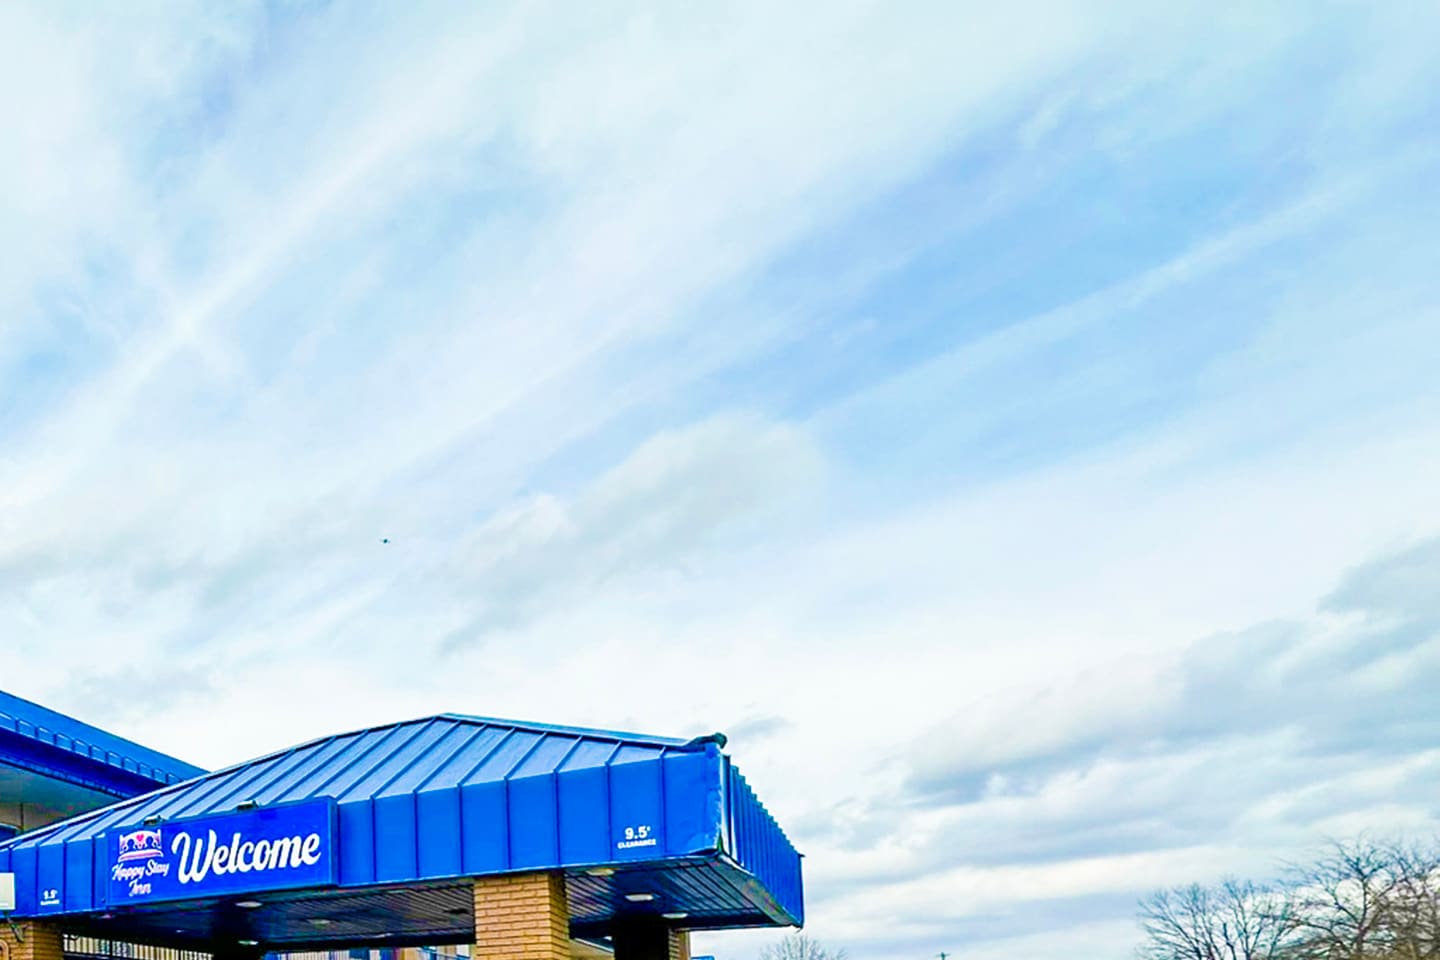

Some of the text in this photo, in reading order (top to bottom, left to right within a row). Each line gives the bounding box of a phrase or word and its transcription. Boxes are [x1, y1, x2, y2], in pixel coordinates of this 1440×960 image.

[171, 829, 321, 884] Welcome
[112, 859, 170, 881] Happy Stay
[128, 879, 152, 897] Inn
